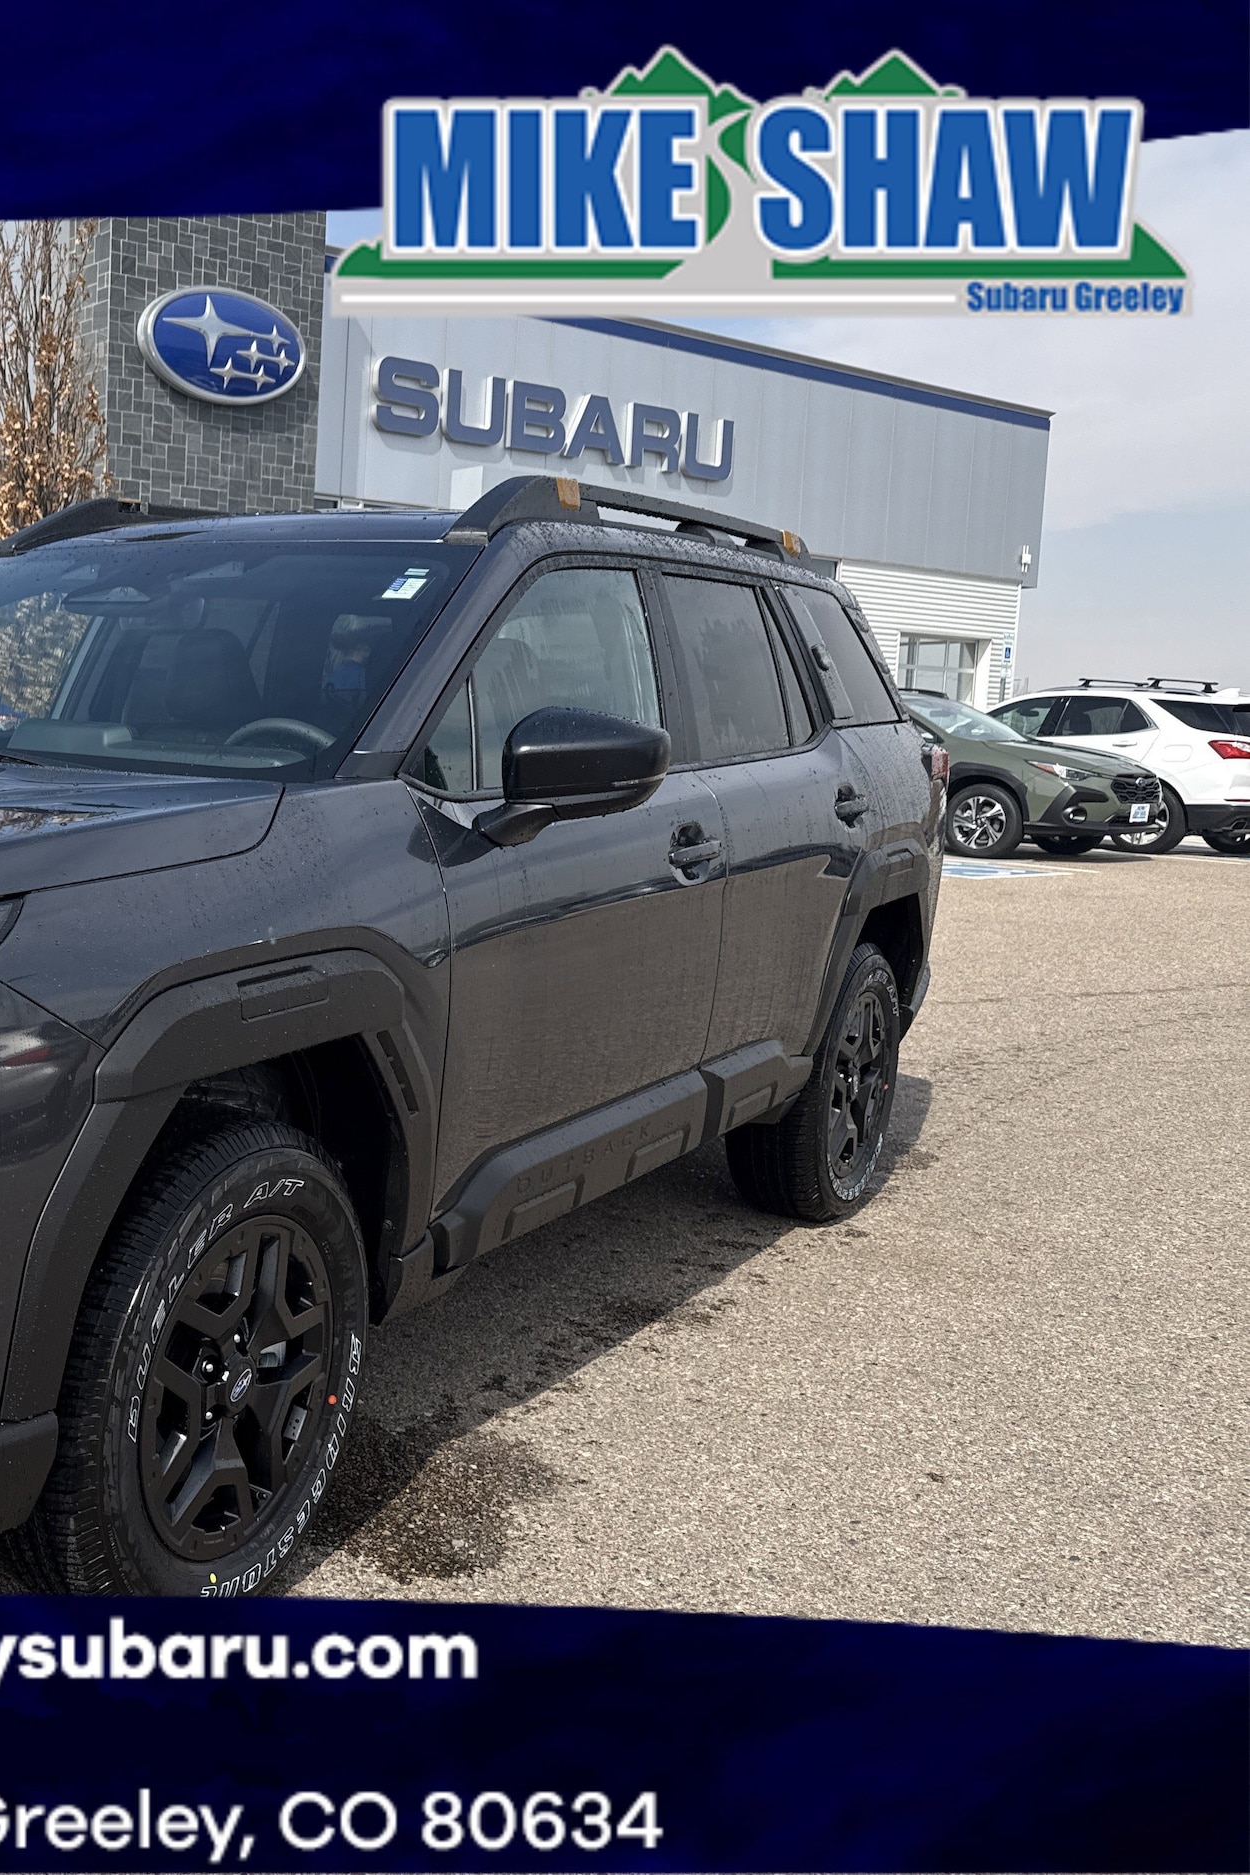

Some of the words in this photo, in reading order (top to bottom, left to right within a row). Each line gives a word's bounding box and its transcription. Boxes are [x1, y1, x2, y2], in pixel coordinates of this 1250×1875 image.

[372, 355, 735, 482] SUBARU
[127, 1203, 234, 1443] DUELER
[243, 1178, 305, 1209] A/T
